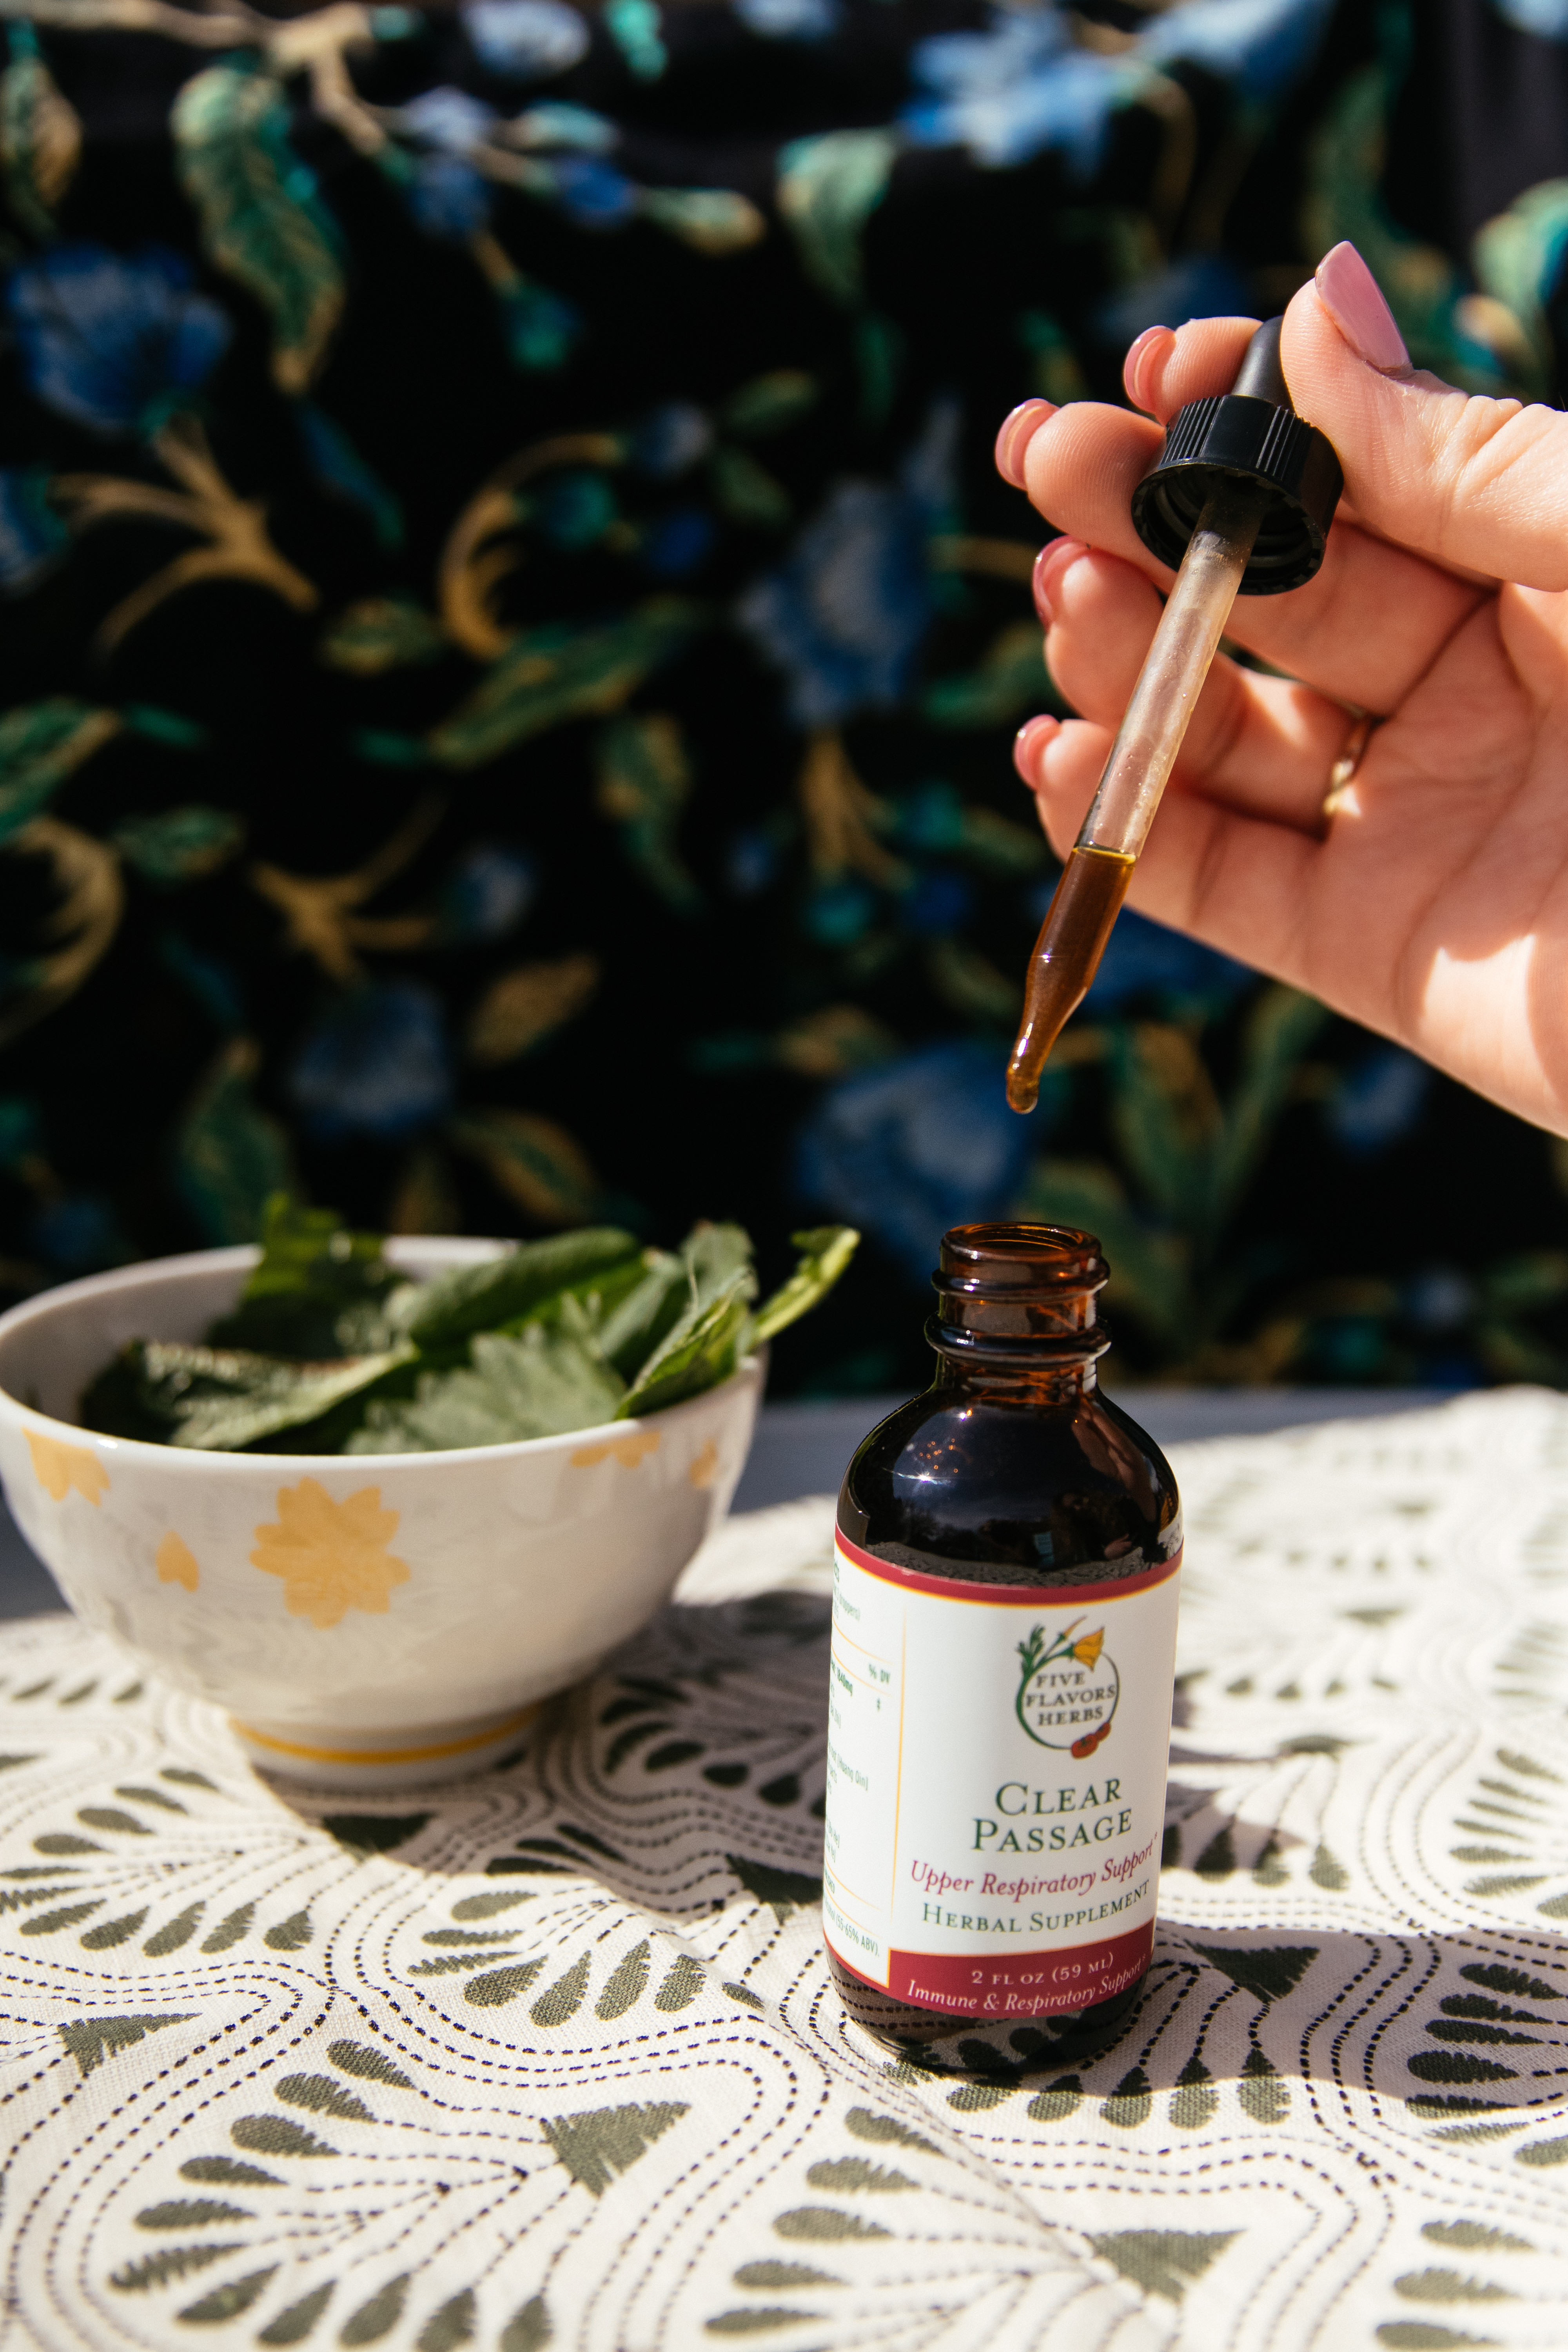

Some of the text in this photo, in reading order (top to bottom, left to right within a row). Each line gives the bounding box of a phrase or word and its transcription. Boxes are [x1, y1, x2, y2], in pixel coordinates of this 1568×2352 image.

[1026, 1684, 1116, 1708] FLAVORS
[1036, 1670, 1085, 1688] FIVE
[1038, 1705, 1103, 1726] HERBS
[995, 1777, 1122, 1816] CLEAR
[971, 1808, 1132, 1853] PASSAGE
[911, 1860, 975, 1896] Upper
[981, 1871, 1097, 1904] Respiratory
[923, 1879, 1150, 1933] HERBAL SUPPLEMENT
[836, 1913, 859, 1944] (55-65%
[971, 1970, 983, 1984] 2
[1052, 1964, 1082, 1984] (59
[907, 1979, 978, 2010] Immune
[983, 1993, 1000, 2011] &
[1005, 1986, 1096, 2016] Respiratory
